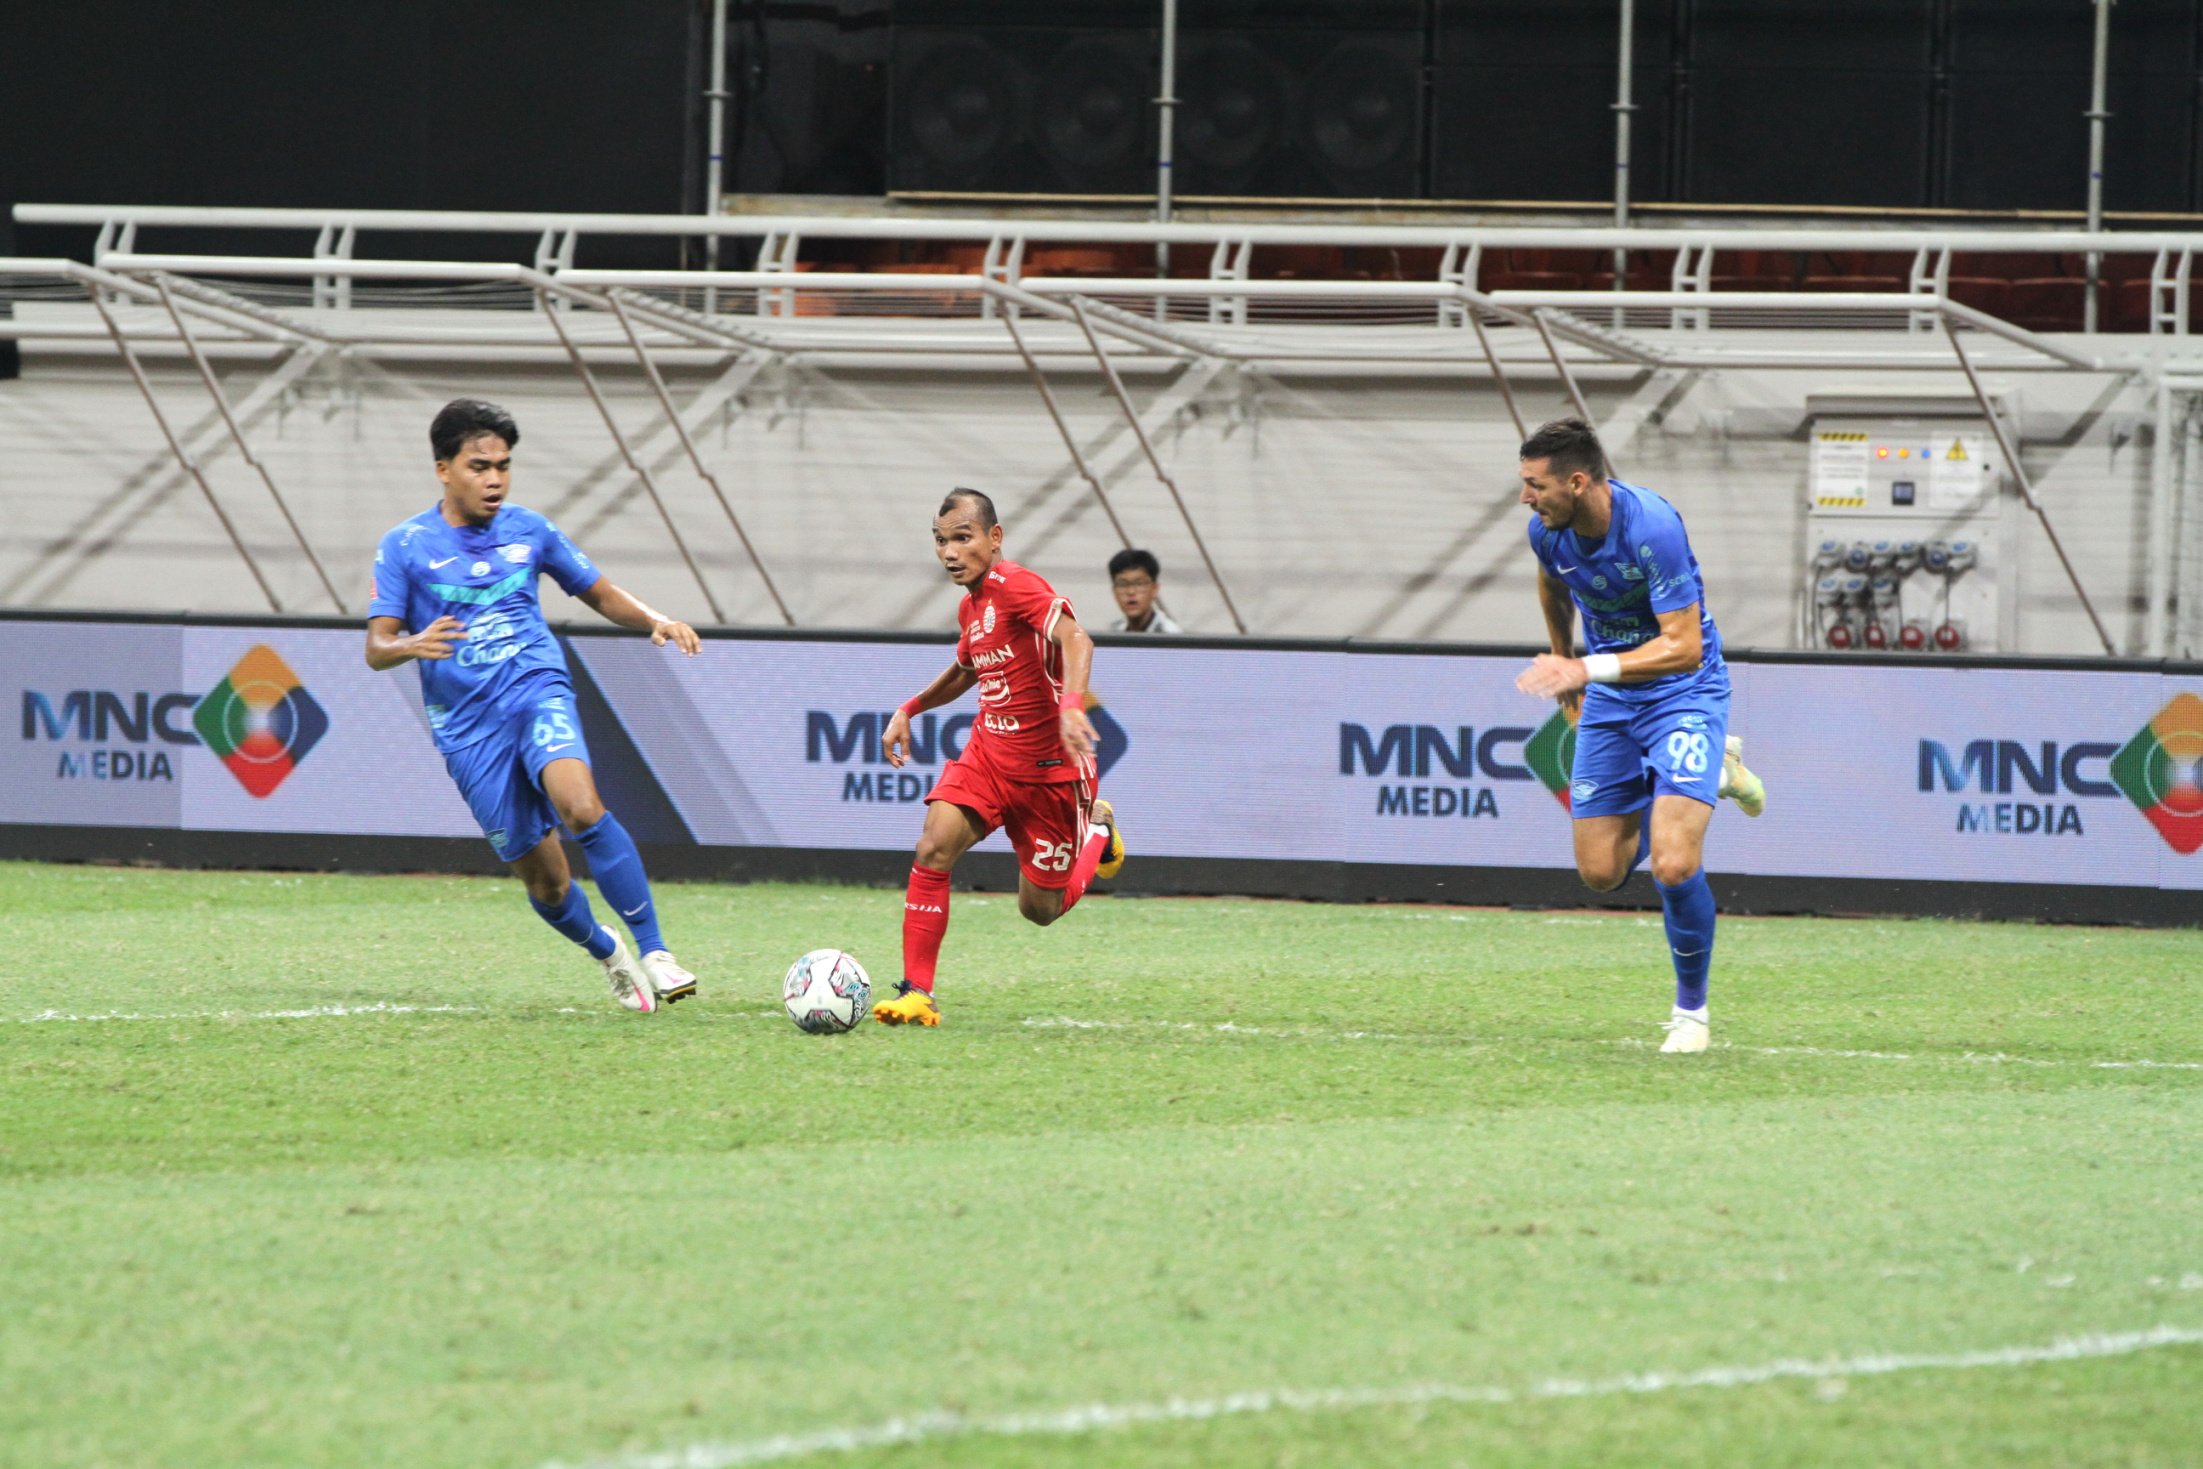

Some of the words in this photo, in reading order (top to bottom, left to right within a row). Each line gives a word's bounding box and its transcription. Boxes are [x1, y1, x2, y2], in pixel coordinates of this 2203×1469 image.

[23, 690, 203, 745] MNC
[532, 712, 576, 747] 65
[57, 751, 173, 781] MEDIA
[1340, 722, 1536, 781] MNC
[1667, 730, 1710, 774] 98
[1918, 738, 2122, 798] MNC
[842, 772, 934, 802] MEDI
[1377, 786, 1499, 818] MEDIA
[1957, 803, 2084, 835] MEDIA
[1032, 838, 1074, 871] 25
